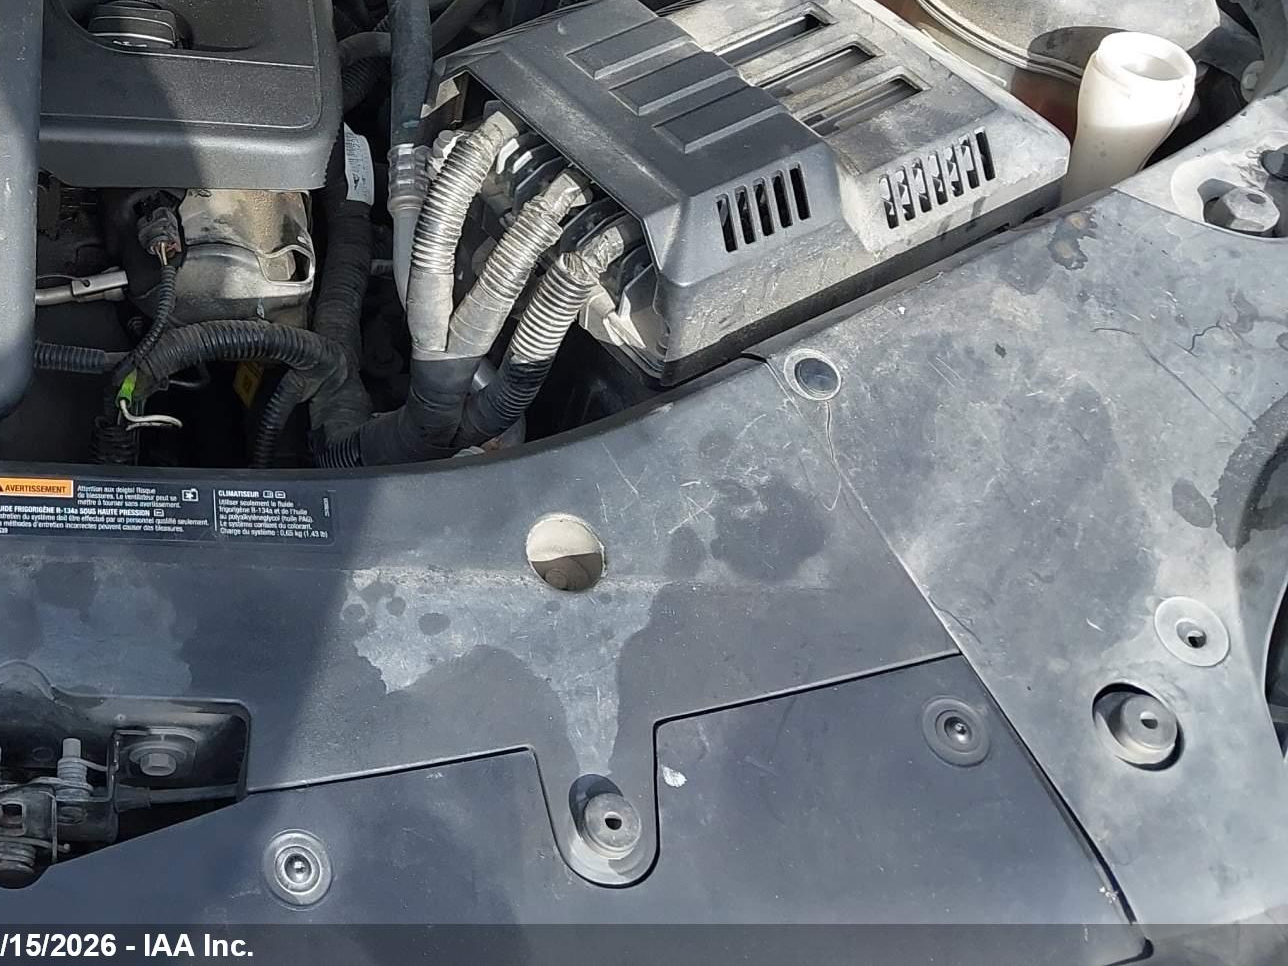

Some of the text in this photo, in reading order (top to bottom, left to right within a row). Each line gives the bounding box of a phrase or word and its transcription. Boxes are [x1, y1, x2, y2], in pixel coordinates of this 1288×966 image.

[5, 484, 67, 494] AVERTISSEMENT
[220, 506, 250, 514] frigorigène
[220, 528, 241, 536] Charge
